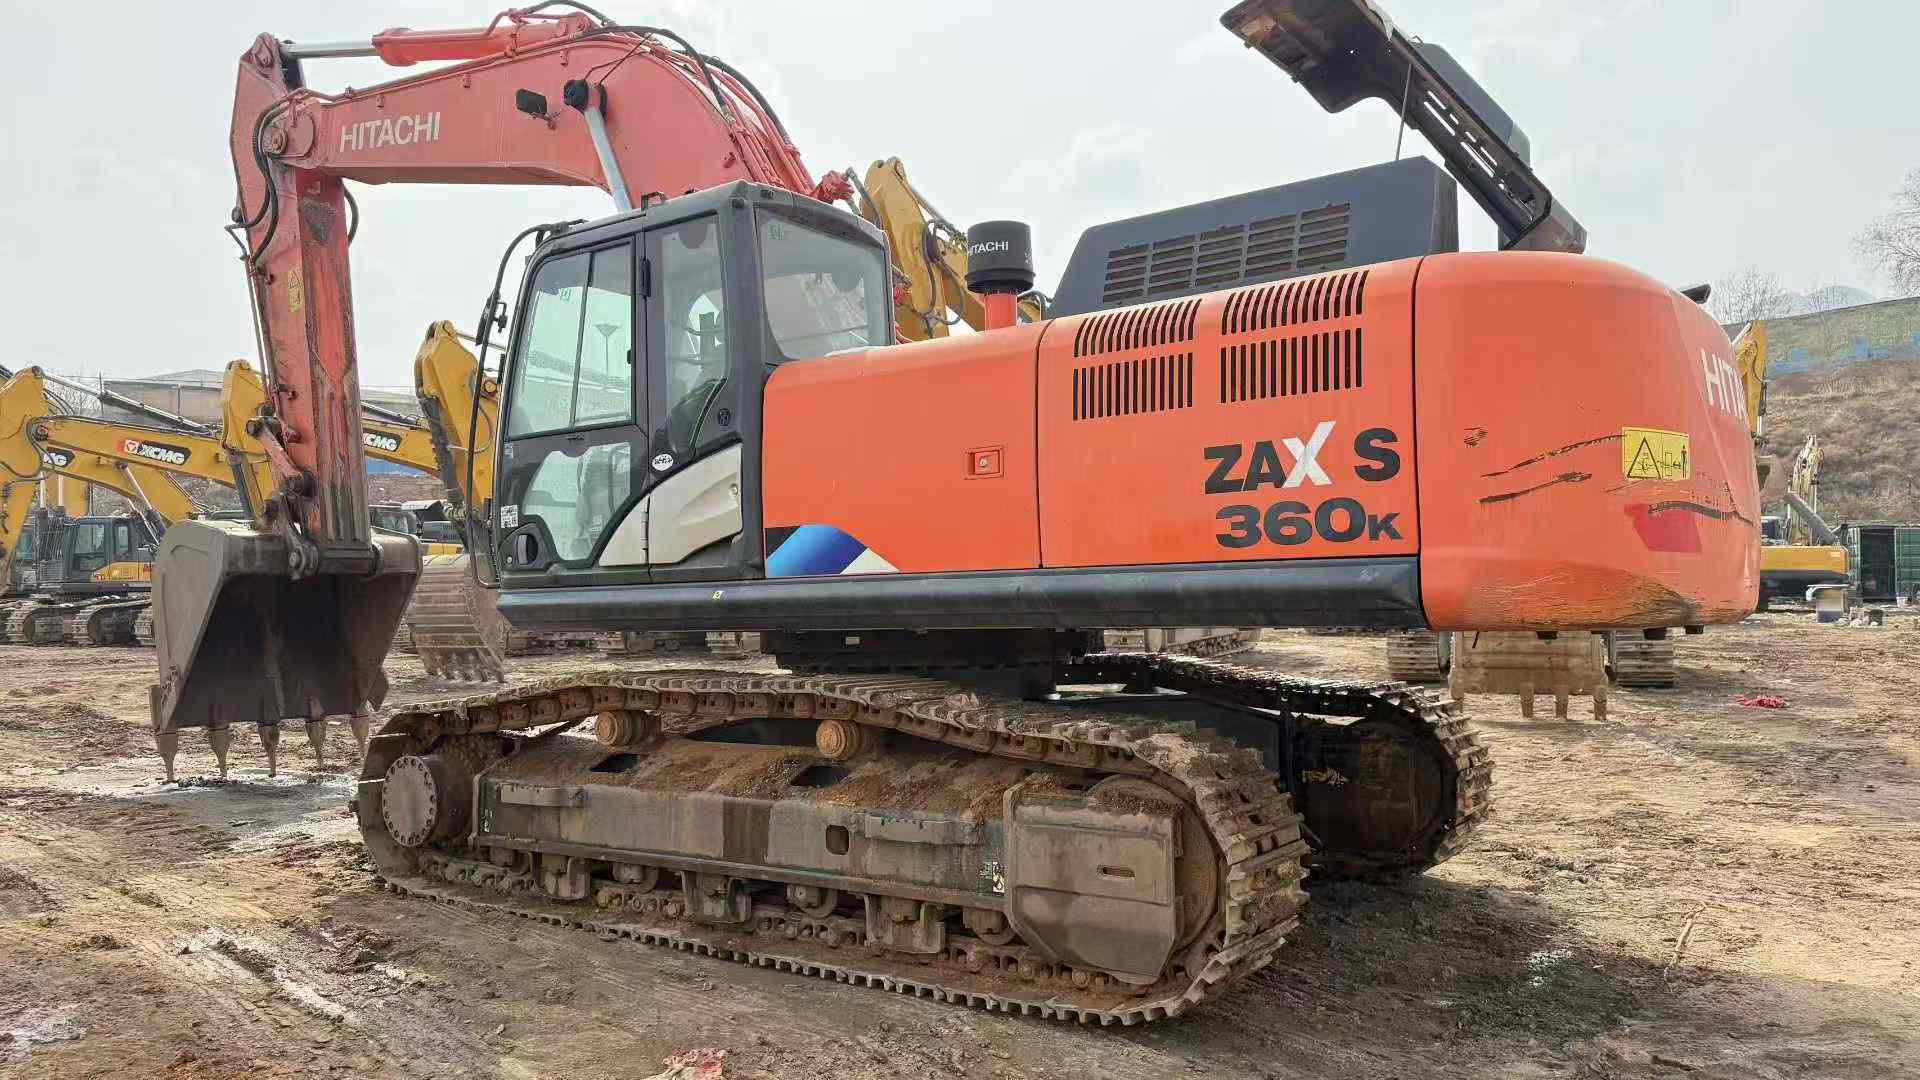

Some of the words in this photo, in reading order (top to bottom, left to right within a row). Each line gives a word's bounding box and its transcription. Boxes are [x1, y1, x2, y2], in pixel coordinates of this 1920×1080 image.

[340, 111, 441, 153] HITACHI
[968, 241, 1009, 256] ITACHI
[138, 443, 185, 465] XCMG
[1216, 497, 1404, 549] 360K
